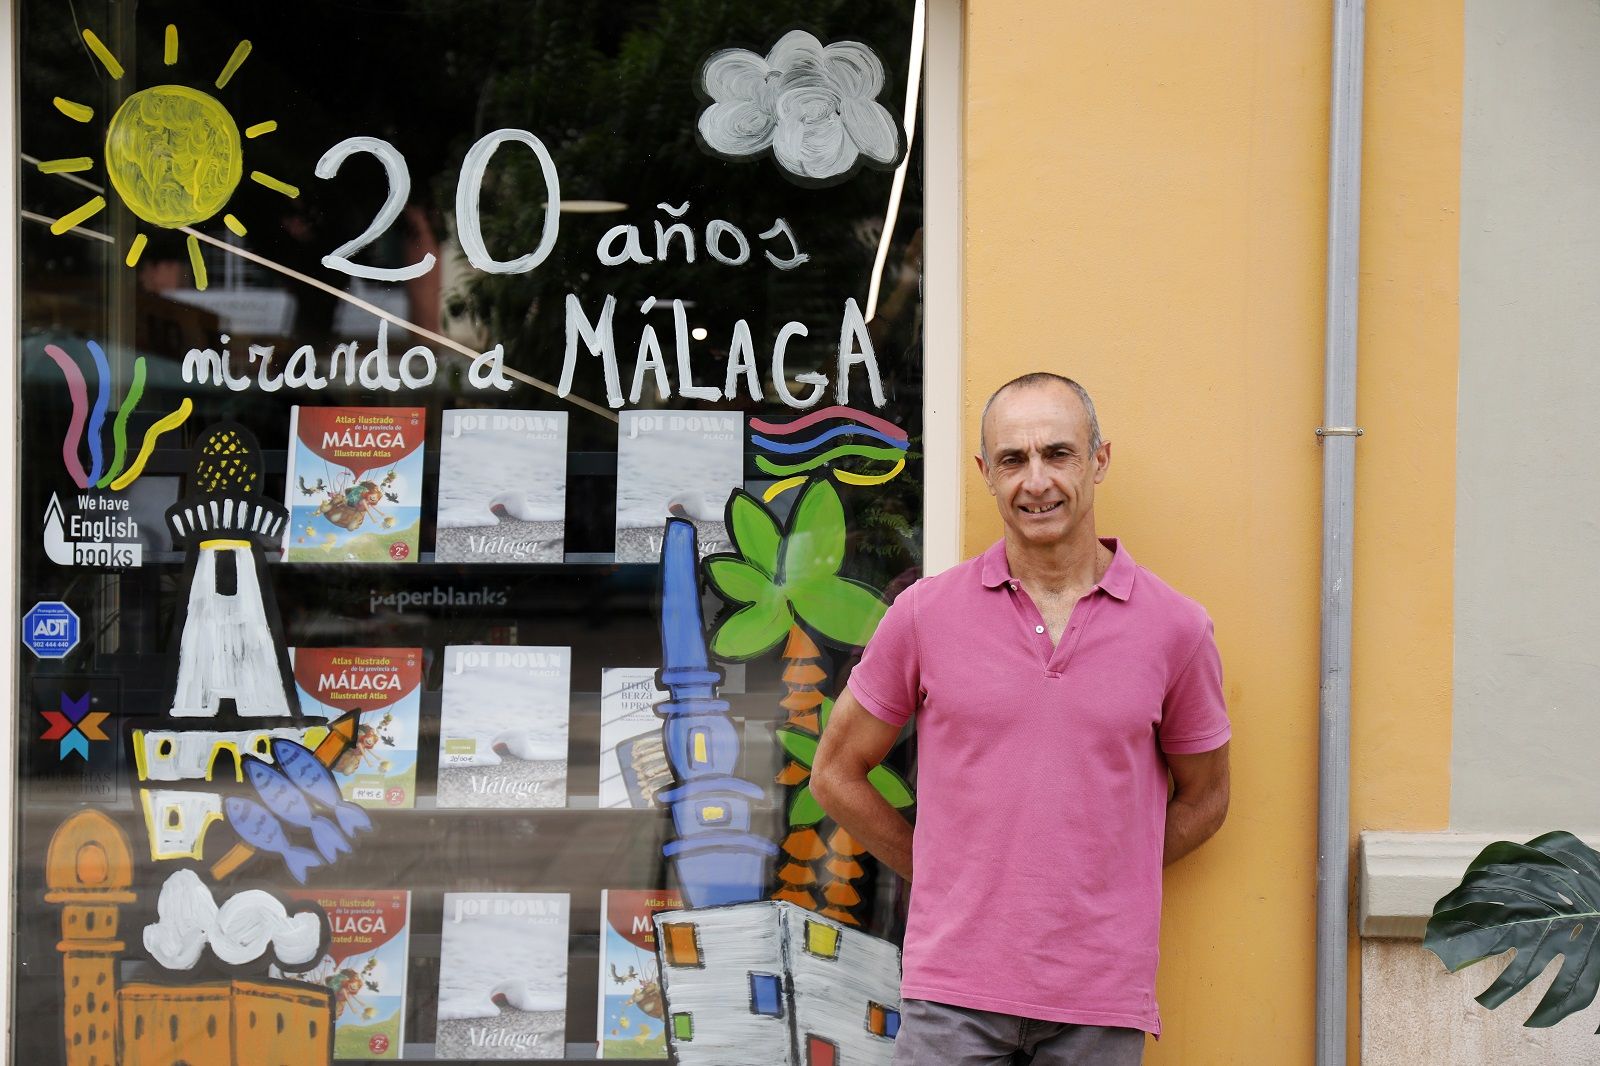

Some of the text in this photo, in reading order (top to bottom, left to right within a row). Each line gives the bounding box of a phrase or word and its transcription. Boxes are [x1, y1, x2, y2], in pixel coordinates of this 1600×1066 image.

[315, 128, 809, 281] 20 años
[182, 293, 887, 408] mirando a MÁLAGA
[335, 415, 394, 424] Atlas ilustrado
[451, 415, 559, 438] JOT DOWN
[627, 416, 735, 439] JOT DOWN
[322, 428, 405, 449] MÁLAGA
[77, 495, 129, 511] We have
[70, 515, 138, 543] English
[74, 542, 133, 567] books
[464, 536, 538, 560] Málaga
[34, 619, 68, 636] ADT
[331, 656, 390, 665] Atlas ilustrado
[453, 652, 560, 675] JOT DOWN
[318, 669, 402, 692] MÁLAGA
[330, 692, 388, 700] Illustrated Atlas
[467, 776, 540, 799] Málaga
[338, 898, 375, 907] ilustrado
[453, 899, 560, 924] JOT DOWN
[644, 899, 665, 907] Atlas
[353, 935, 372, 943] Atlas
[464, 1027, 539, 1052] Málaga
